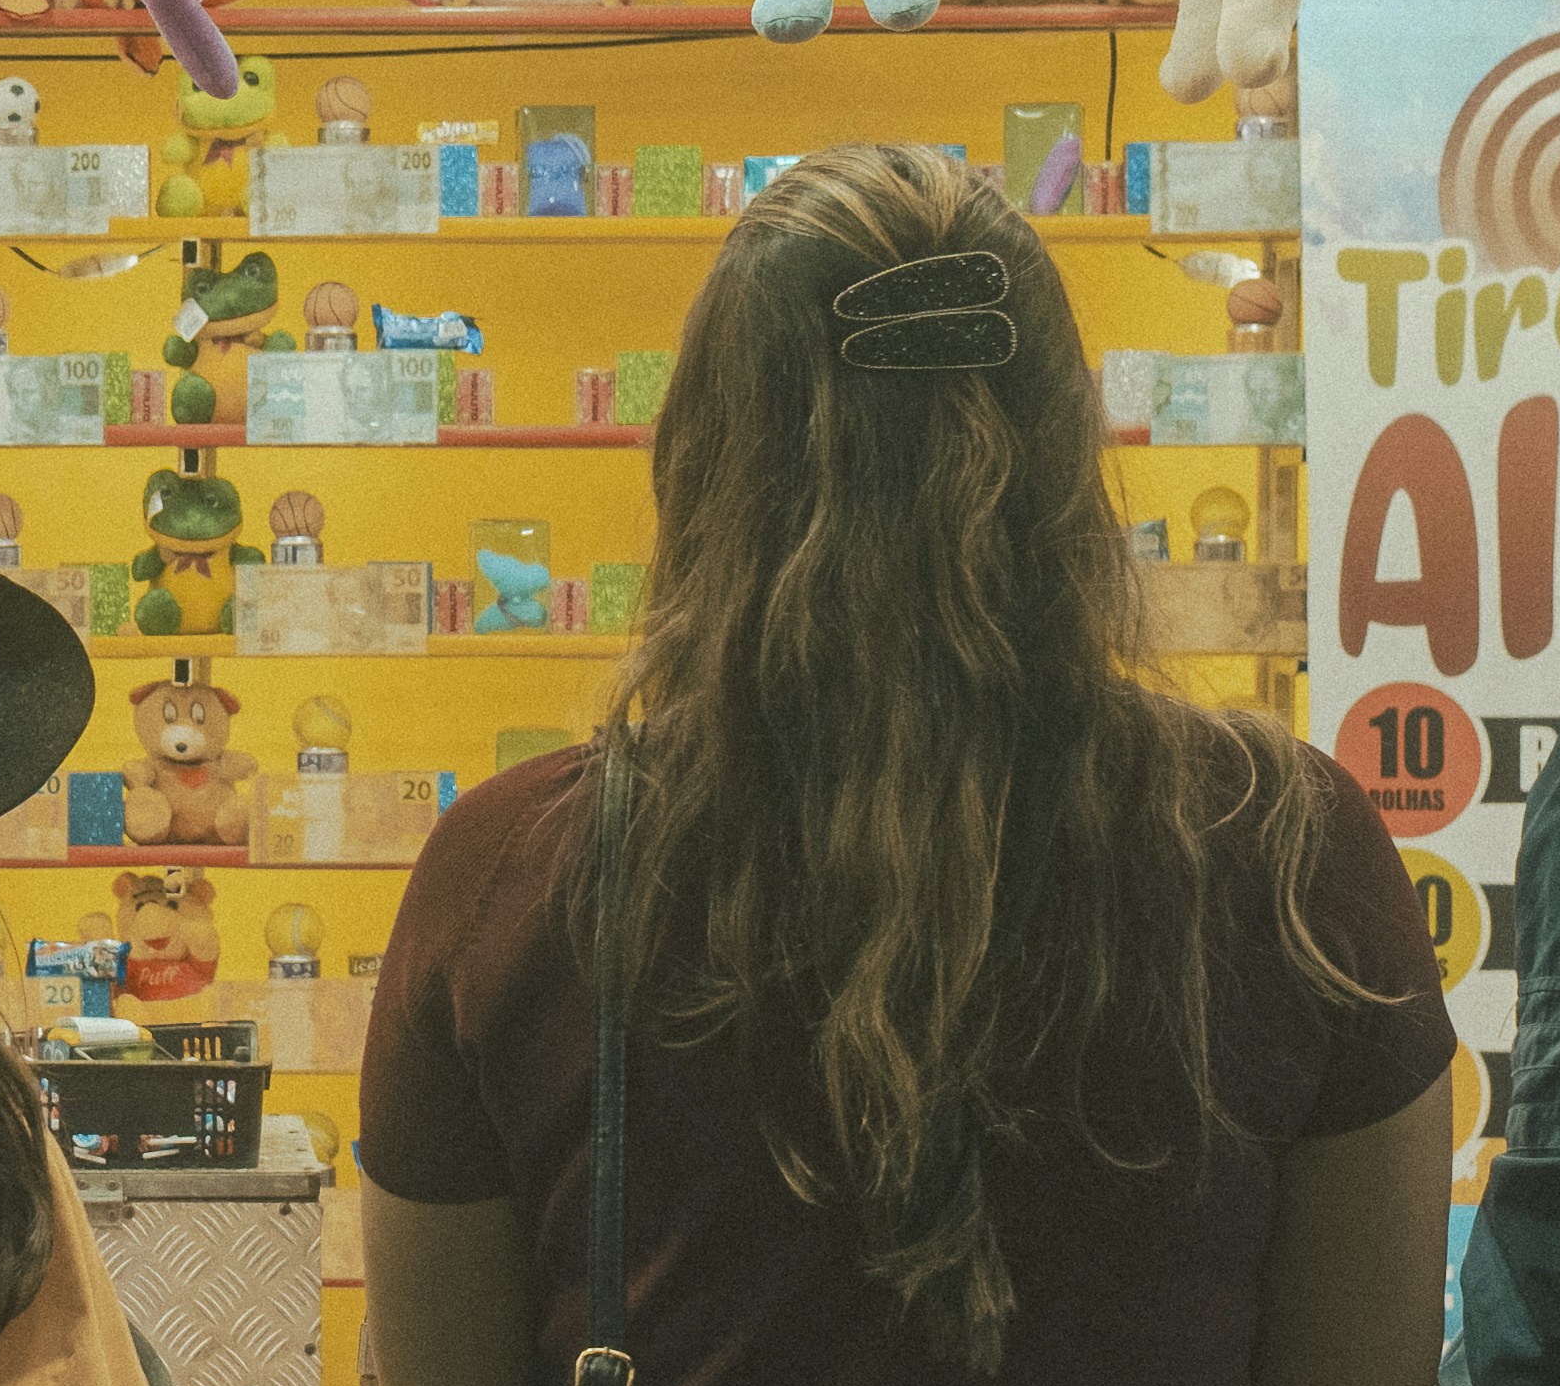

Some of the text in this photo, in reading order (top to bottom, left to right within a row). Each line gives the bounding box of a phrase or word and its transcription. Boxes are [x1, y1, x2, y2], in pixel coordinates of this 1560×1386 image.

[71, 153, 100, 171] 200
[402, 152, 431, 170] 200
[64, 361, 99, 380] 100
[398, 357, 432, 377] 100
[55, 571, 85, 591] 50
[393, 568, 422, 587] 50
[1369, 706, 1445, 780] 10
[1519, 724, 1558, 792] R
[402, 781, 431, 802] 20
[45, 985, 74, 1006] 20
